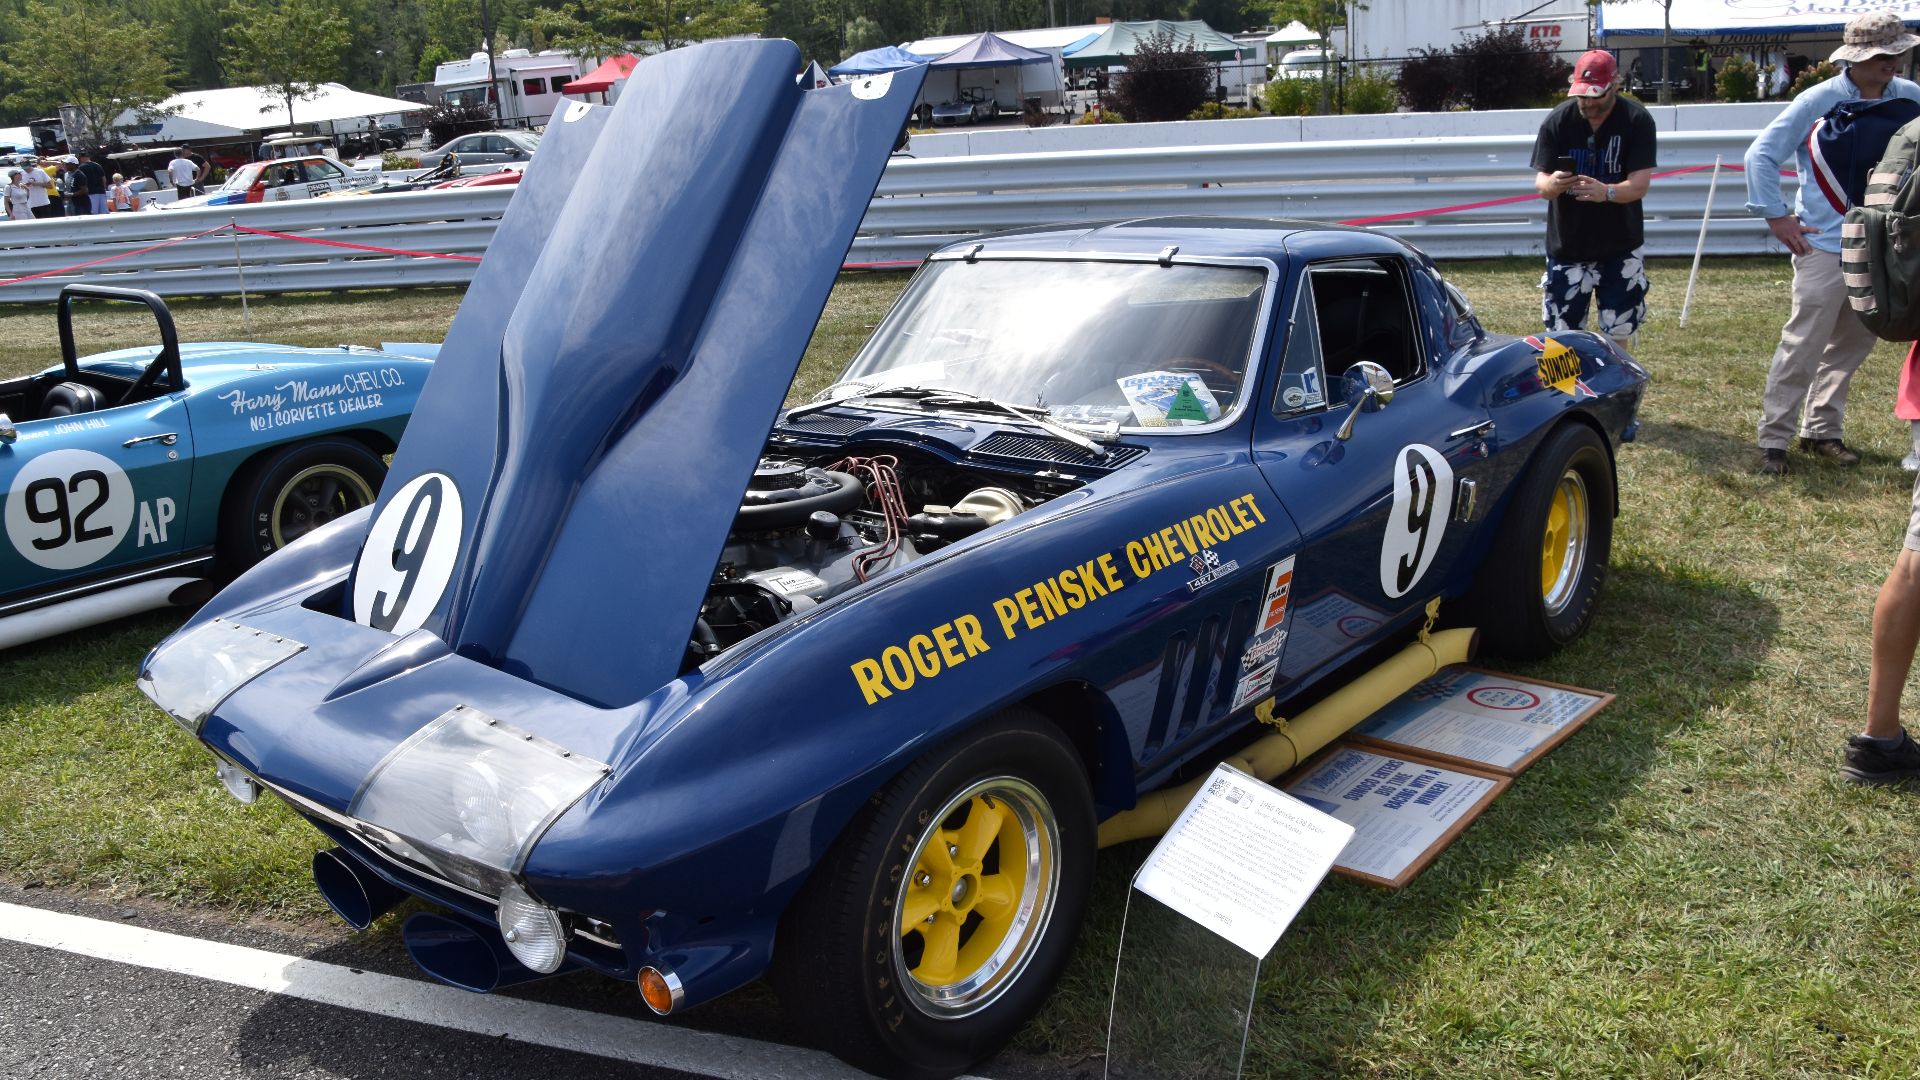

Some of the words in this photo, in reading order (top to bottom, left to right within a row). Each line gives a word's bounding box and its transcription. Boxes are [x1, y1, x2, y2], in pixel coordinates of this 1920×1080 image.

[1528, 38, 1562, 49] Racing
[1529, 25, 1562, 38] KTR
[1604, 134, 1622, 174] 42
[307, 182, 330, 191] DEKRA
[1537, 348, 1581, 387] SUNOCO
[218, 389, 286, 415] Harry
[275, 380, 345, 403] Mann
[344, 371, 382, 394] CHEV.
[381, 368, 405, 388] CO.
[275, 402, 337, 427] CORVETTE
[340, 393, 383, 414] DEALER
[54, 421, 85, 435] JOHN
[85, 417, 111, 429] HILL
[25, 469, 114, 550] 92
[137, 497, 176, 548] AP
[1396, 448, 1437, 593] 9
[369, 476, 443, 633] 9
[1194, 574, 1211, 587] 427
[1267, 585, 1287, 602] FRAM
[850, 613, 991, 705] ROGER
[992, 552, 1125, 640] PENSKE
[1126, 493, 1267, 579] CHEVROLET
[1207, 787, 1224, 798] PARK
[1210, 781, 1228, 794] ROCK
[1214, 776, 1232, 788] LIME
[1342, 777, 1381, 802] SUNOCO
[1370, 759, 1405, 781] ENTERS
[1373, 782, 1397, 797] BIG
[1385, 771, 1413, 788] TIME
[1382, 787, 1419, 810] RACING
[1409, 773, 1434, 790] WITH
[1413, 780, 1453, 806] WINNER!
